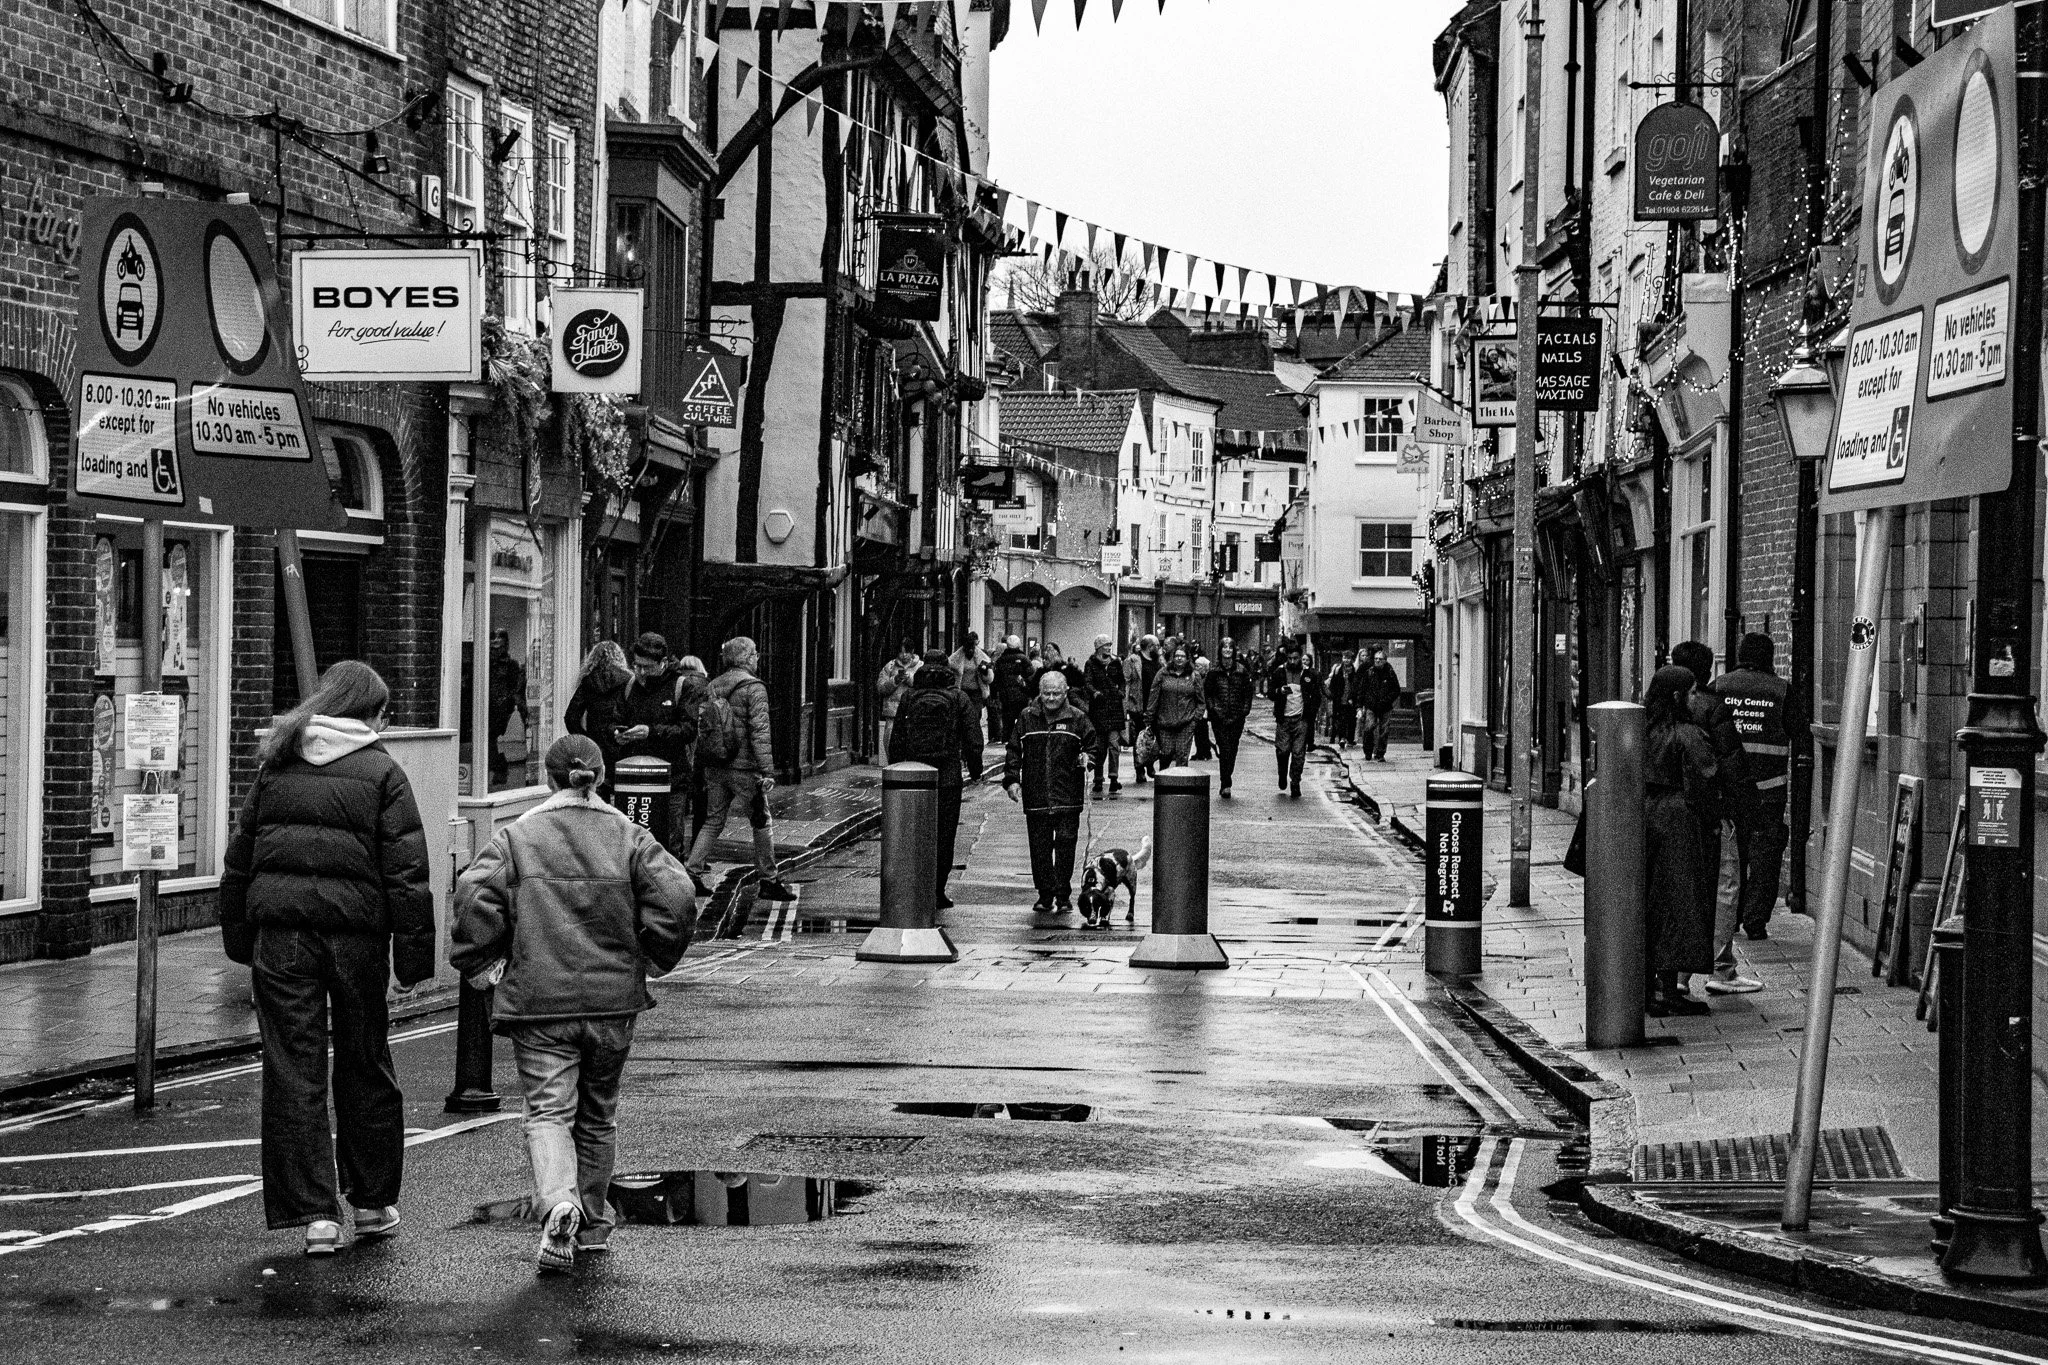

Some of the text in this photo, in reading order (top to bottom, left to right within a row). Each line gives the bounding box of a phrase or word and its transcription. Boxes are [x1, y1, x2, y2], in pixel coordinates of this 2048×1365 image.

[1645, 122, 1710, 172] goji
[1649, 174, 1705, 188] Vegetarian
[1648, 189, 1705, 201] Cafe & Deli
[880, 272, 939, 286] LA PIAZZA
[313, 286, 459, 308] BOYES
[328, 320, 355, 338] for
[351, 320, 397, 342] good
[572, 317, 619, 346] Fancy
[1944, 303, 1996, 342] No vehicles
[1537, 332, 1597, 346] FACIALS
[1853, 338, 1874, 367] 8.00
[1879, 329, 1904, 362] 10.30
[1905, 331, 1918, 353] am
[1541, 351, 1582, 363] NAILS
[1933, 348, 1959, 381] 10.30
[1960, 351, 1973, 373] am
[1980, 340, 1986, 368] 5
[1986, 342, 2001, 372] pm
[1858, 366, 1902, 399] except for
[85, 383, 113, 405] 8.00
[121, 387, 152, 409] 10.30
[154, 397, 171, 411] am
[1535, 389, 1584, 400] WAXING
[208, 395, 281, 421] No vehicles
[687, 404, 730, 415] COFFEE
[99, 414, 155, 435] except for
[1424, 416, 1461, 428] Barbers
[196, 421, 233, 443] 10.30
[236, 428, 257, 446] am
[264, 426, 275, 446] 5
[277, 430, 301, 450] pm
[1429, 428, 1454, 441] Shop
[1837, 426, 1889, 461] loading and
[81, 453, 148, 479] loading and
[1234, 603, 1263, 614] wagamama
[1724, 697, 1774, 708] City Centre
[1732, 708, 1765, 718] Access
[1742, 723, 1763, 732] YORK
[639, 796, 652, 827] Enjoy
[1437, 832, 1449, 896] Not Regrets
[1449, 811, 1462, 899] Choose Respect
